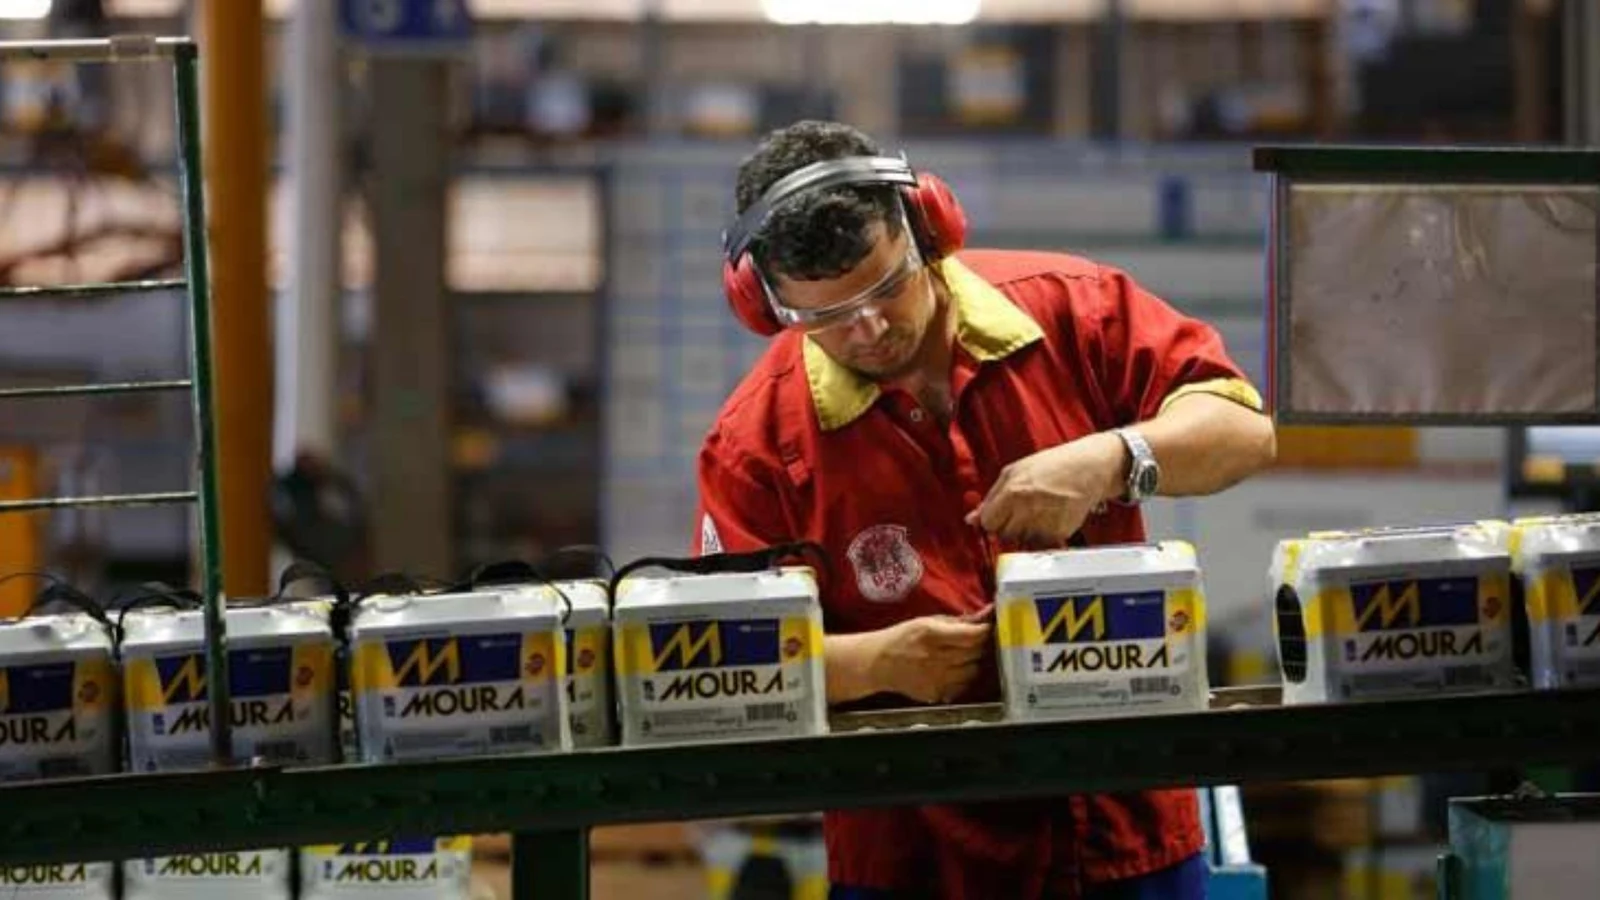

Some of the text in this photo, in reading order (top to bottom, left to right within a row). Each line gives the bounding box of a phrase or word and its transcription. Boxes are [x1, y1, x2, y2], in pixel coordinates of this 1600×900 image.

[1047, 643, 1169, 673] MOURA
[1361, 628, 1483, 662] MOURA
[660, 668, 783, 701] MOURA
[169, 698, 294, 735] MURA
[401, 686, 525, 718] MOURA
[159, 852, 262, 876] MOURA
[335, 858, 437, 882] MOURA
